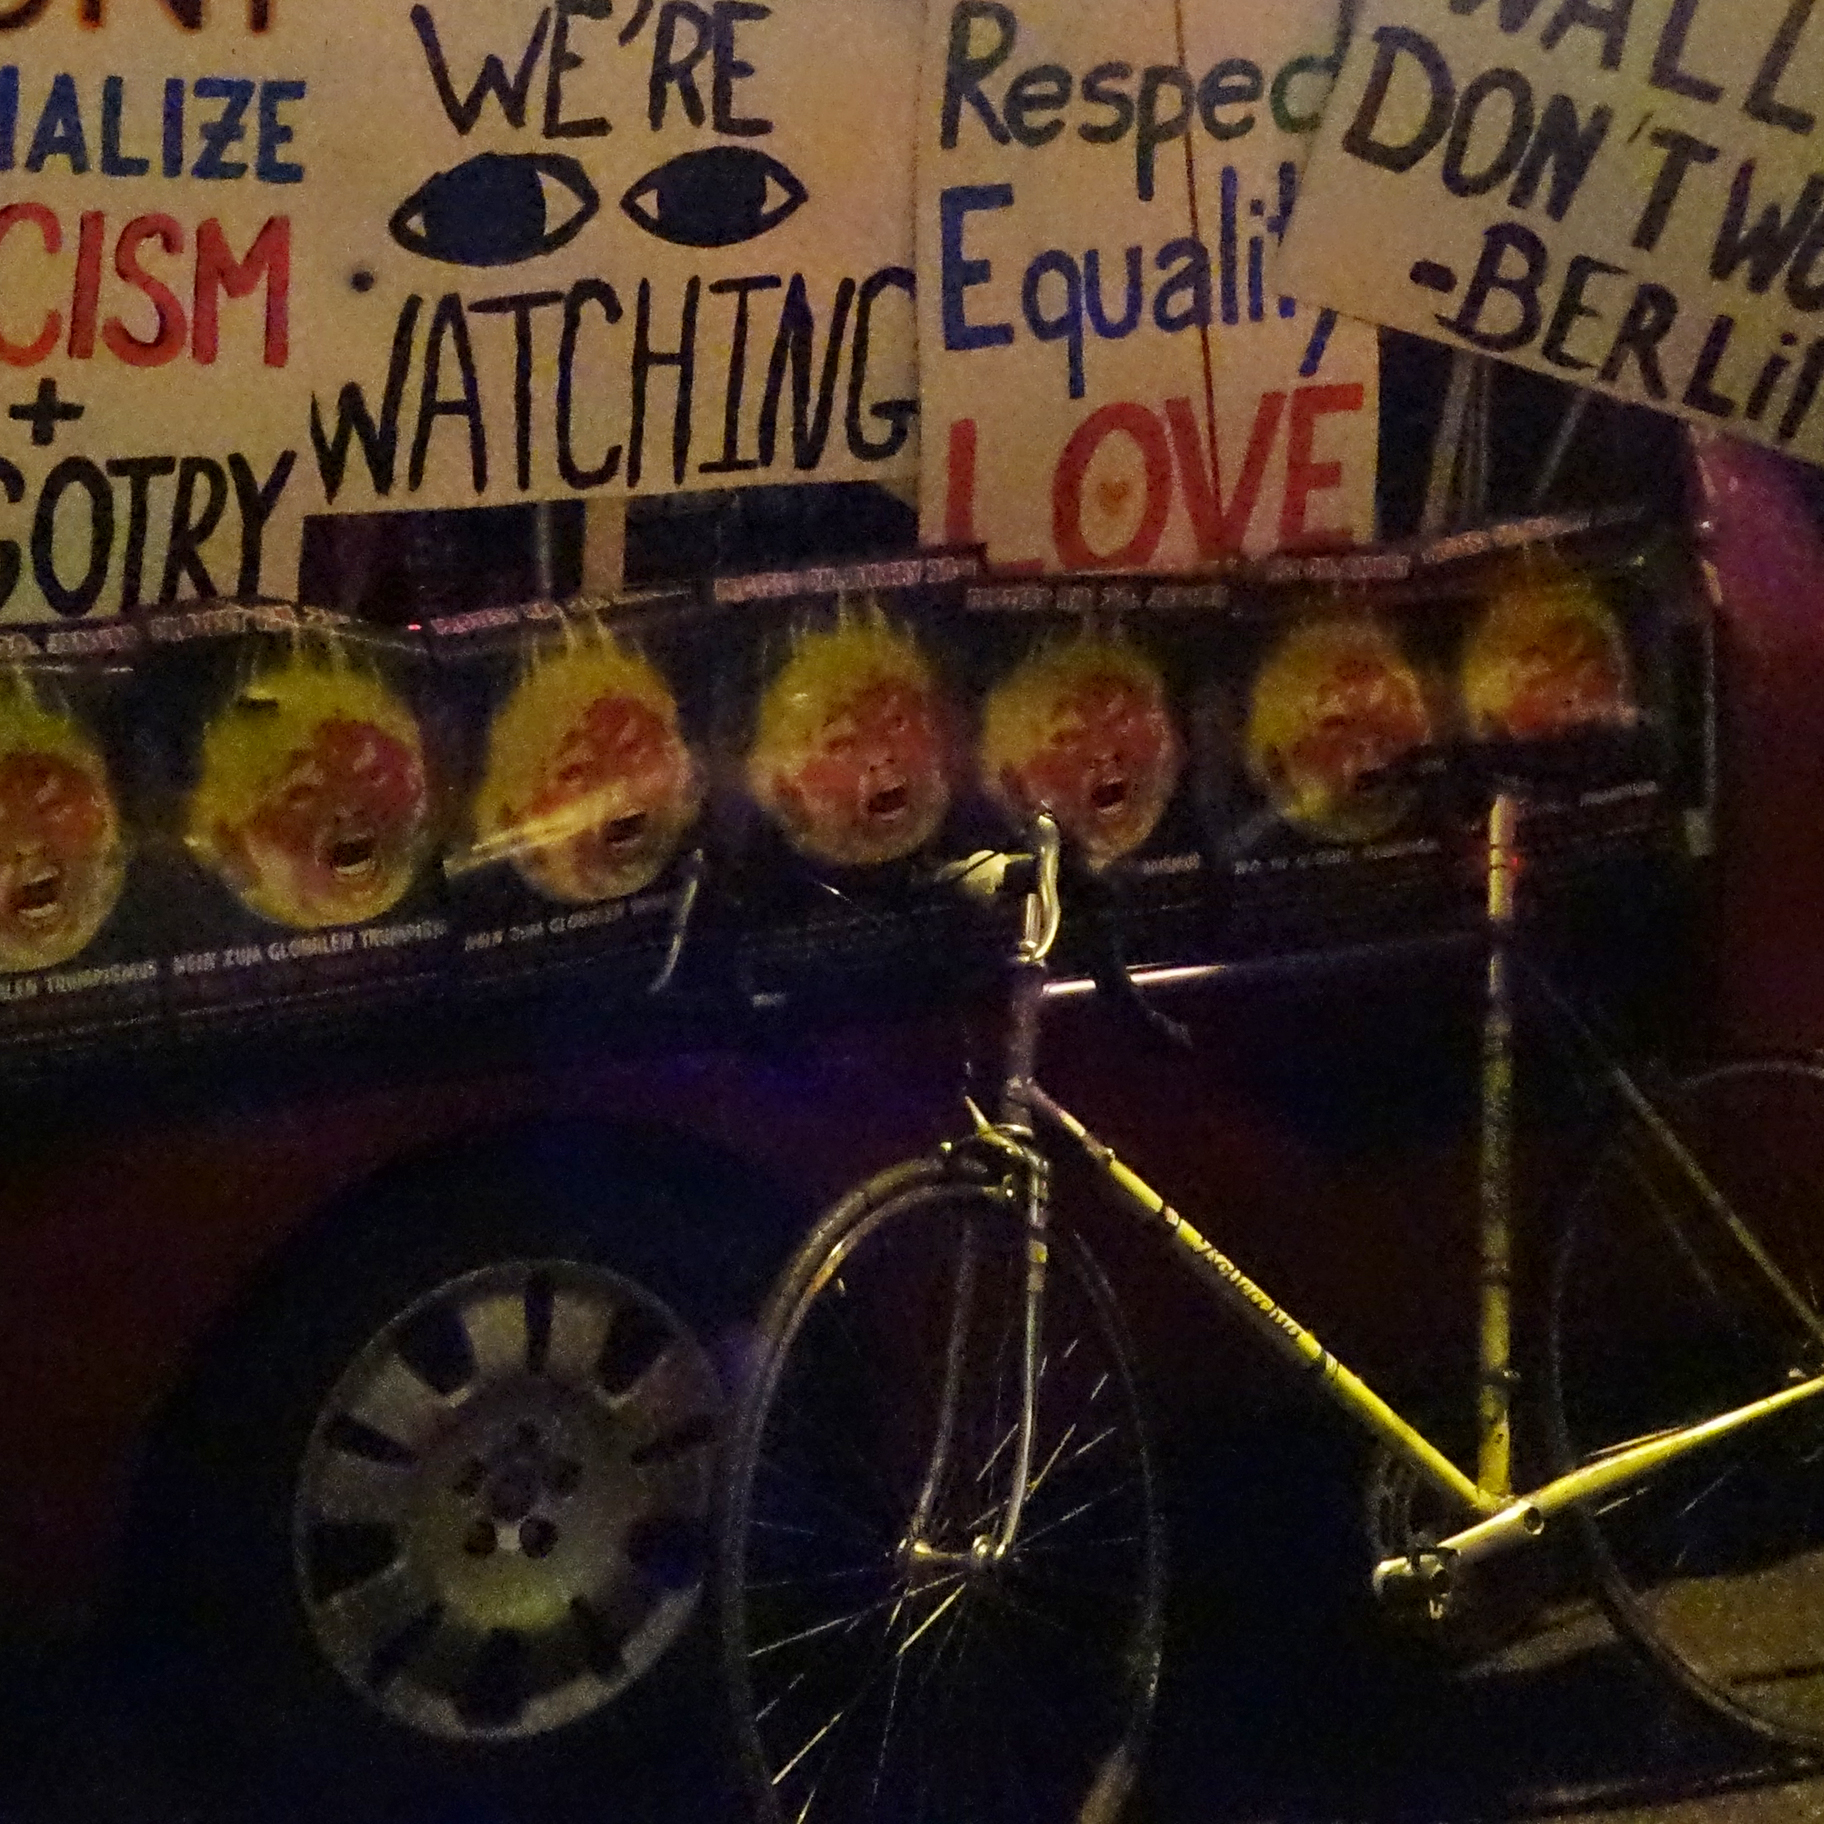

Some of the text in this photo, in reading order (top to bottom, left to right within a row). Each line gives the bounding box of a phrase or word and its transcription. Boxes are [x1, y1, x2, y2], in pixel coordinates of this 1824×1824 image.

[1341, 26, 1720, 251] DON'T
[310, 266, 922, 504] WATCHING
[945, 382, 1364, 574] LOVE
